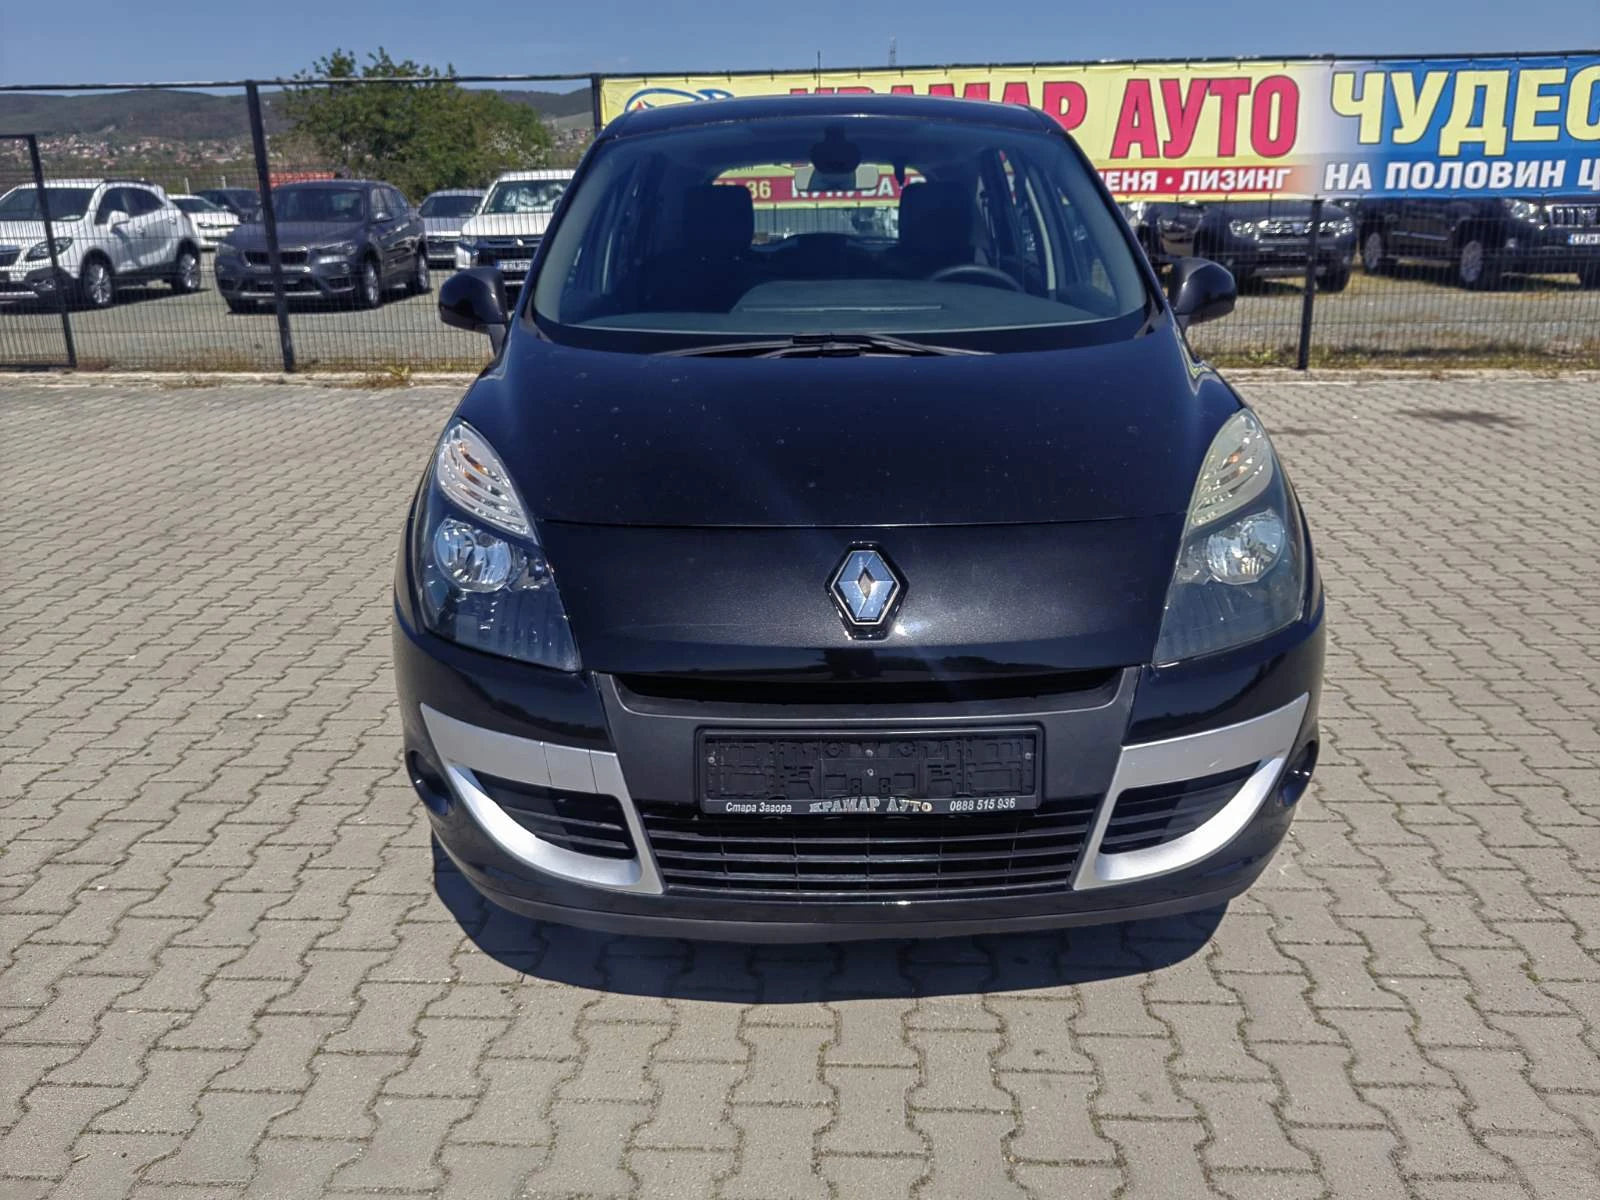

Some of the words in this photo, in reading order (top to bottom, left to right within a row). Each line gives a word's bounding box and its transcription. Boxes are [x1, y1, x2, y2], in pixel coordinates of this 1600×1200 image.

[1110, 75, 1300, 159] АУТО
[1098, 170, 1158, 192] ЕНЯ
[1180, 168, 1291, 191] ЛИЗИНГ
[1324, 162, 1372, 190] НА
[1385, 159, 1564, 189] ПОЛОВИН
[949, 800, 974, 812] 0888
[976, 799, 996, 811] 515
